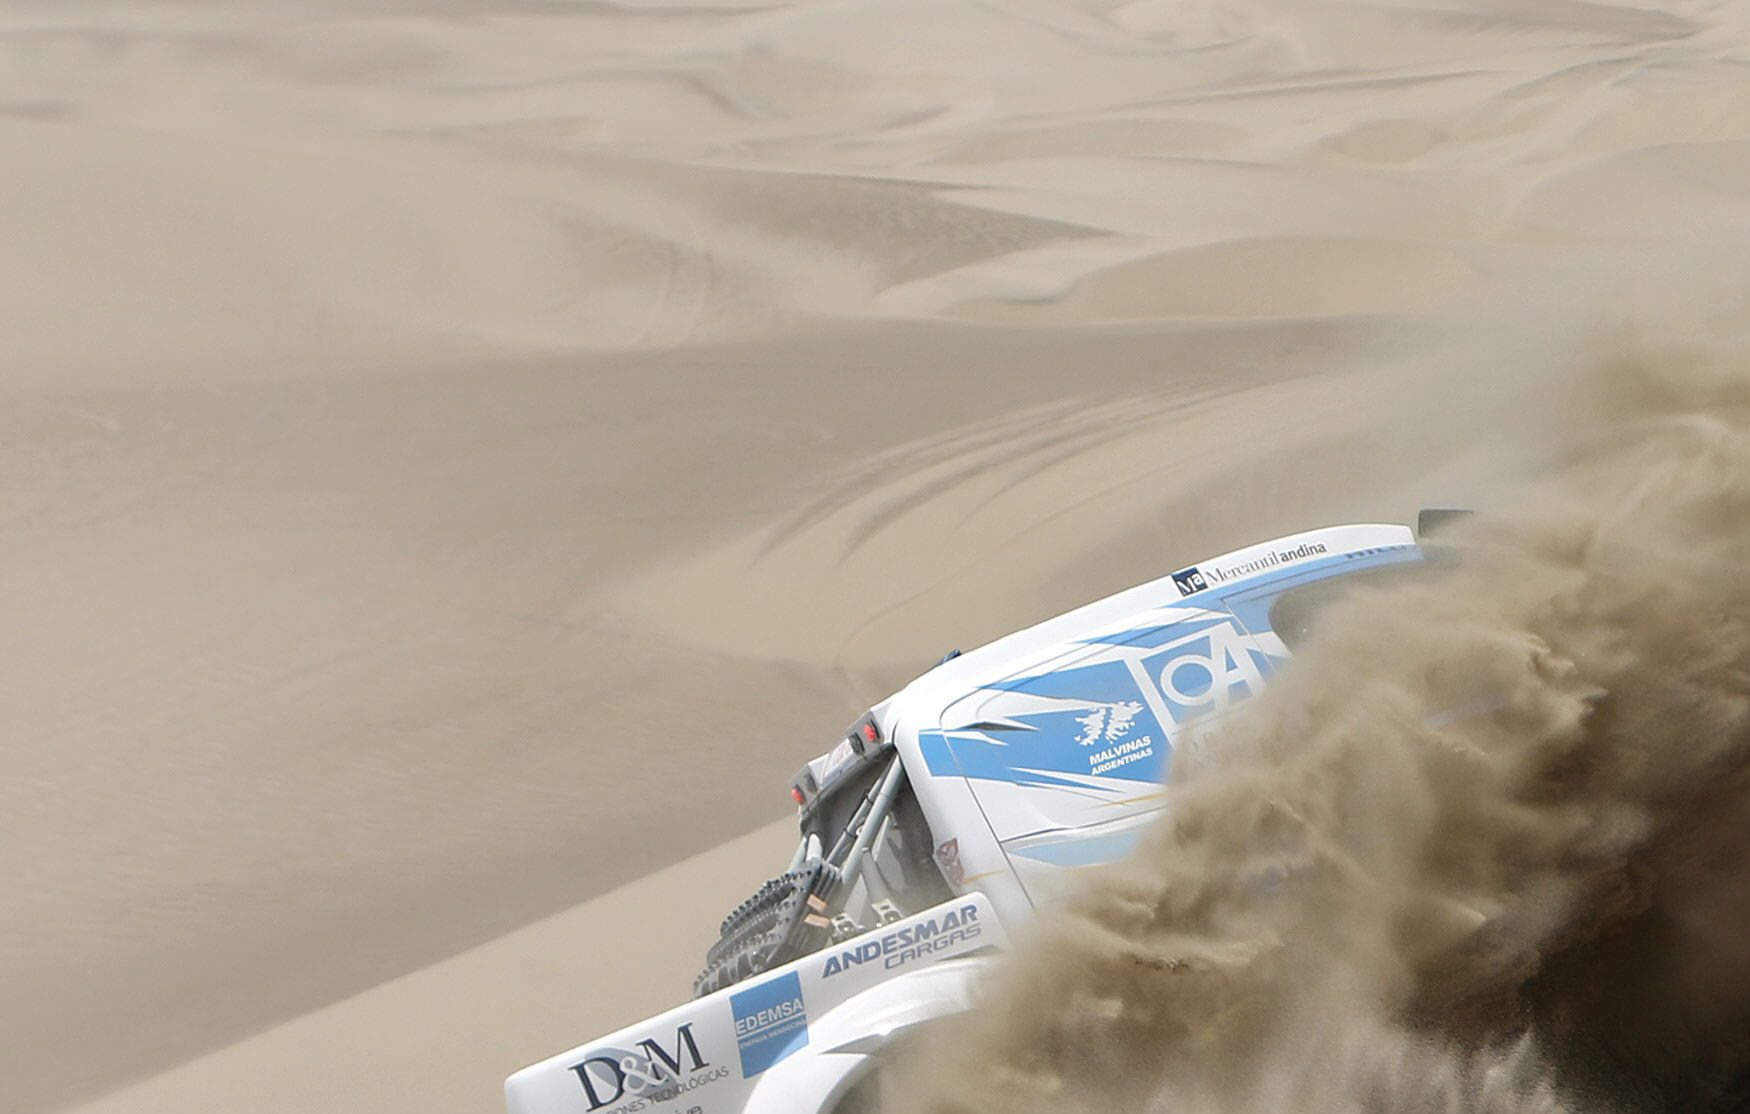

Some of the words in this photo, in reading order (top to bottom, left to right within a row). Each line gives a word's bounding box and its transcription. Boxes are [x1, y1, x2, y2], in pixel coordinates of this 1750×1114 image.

[1279, 543, 1327, 563] andina
[1089, 735, 1152, 766] MALVINAS
[1091, 747, 1153, 776] ARGENTINAS
[822, 904, 978, 979] ANDESMAR
[884, 923, 982, 970] CARGAS
[736, 998, 805, 1035] EDEMSA
